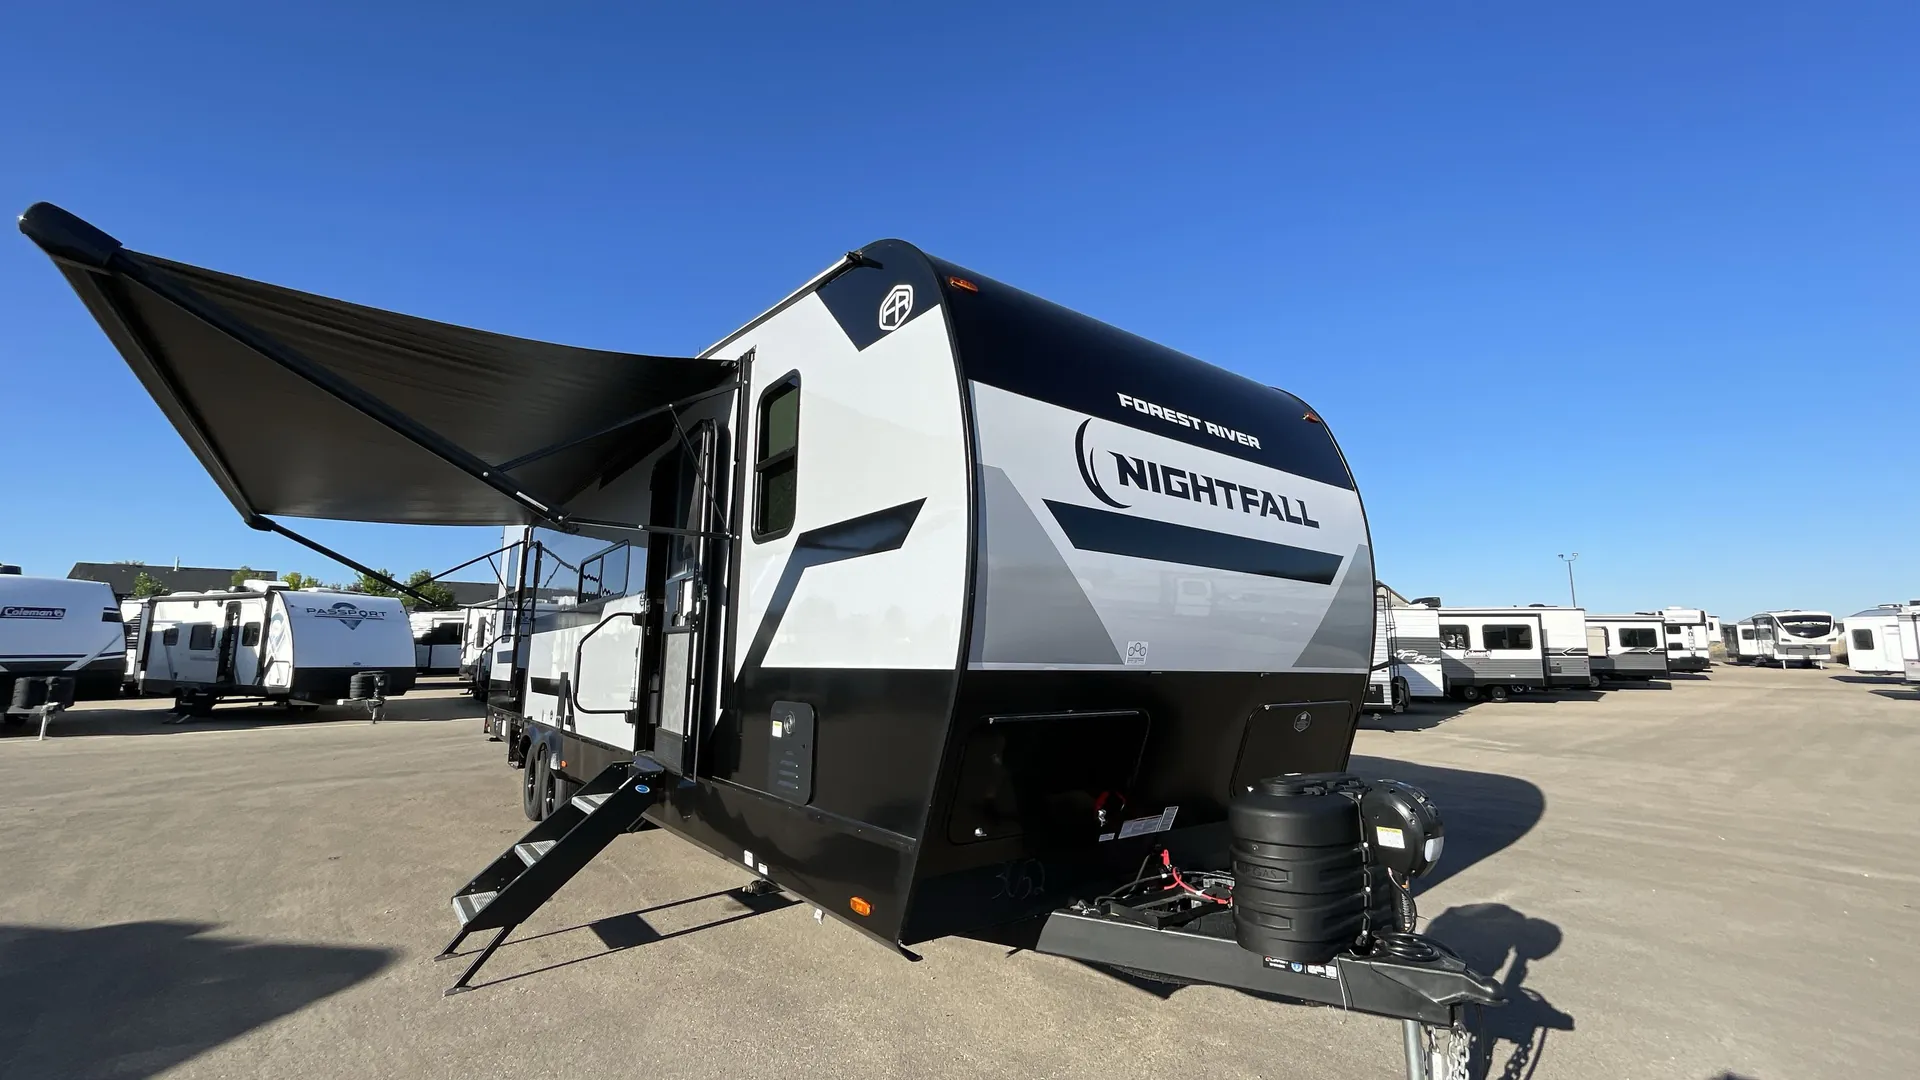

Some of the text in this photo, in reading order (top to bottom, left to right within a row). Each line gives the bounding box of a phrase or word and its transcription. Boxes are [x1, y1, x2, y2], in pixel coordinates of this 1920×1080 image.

[1117, 392, 1262, 450] FOREST RIVER
[1107, 450, 1320, 529] NIGHTFALL
[4, 607, 53, 616] Coleman
[306, 607, 387, 619] PASSPORT
[1252, 866, 1278, 880] GAS
